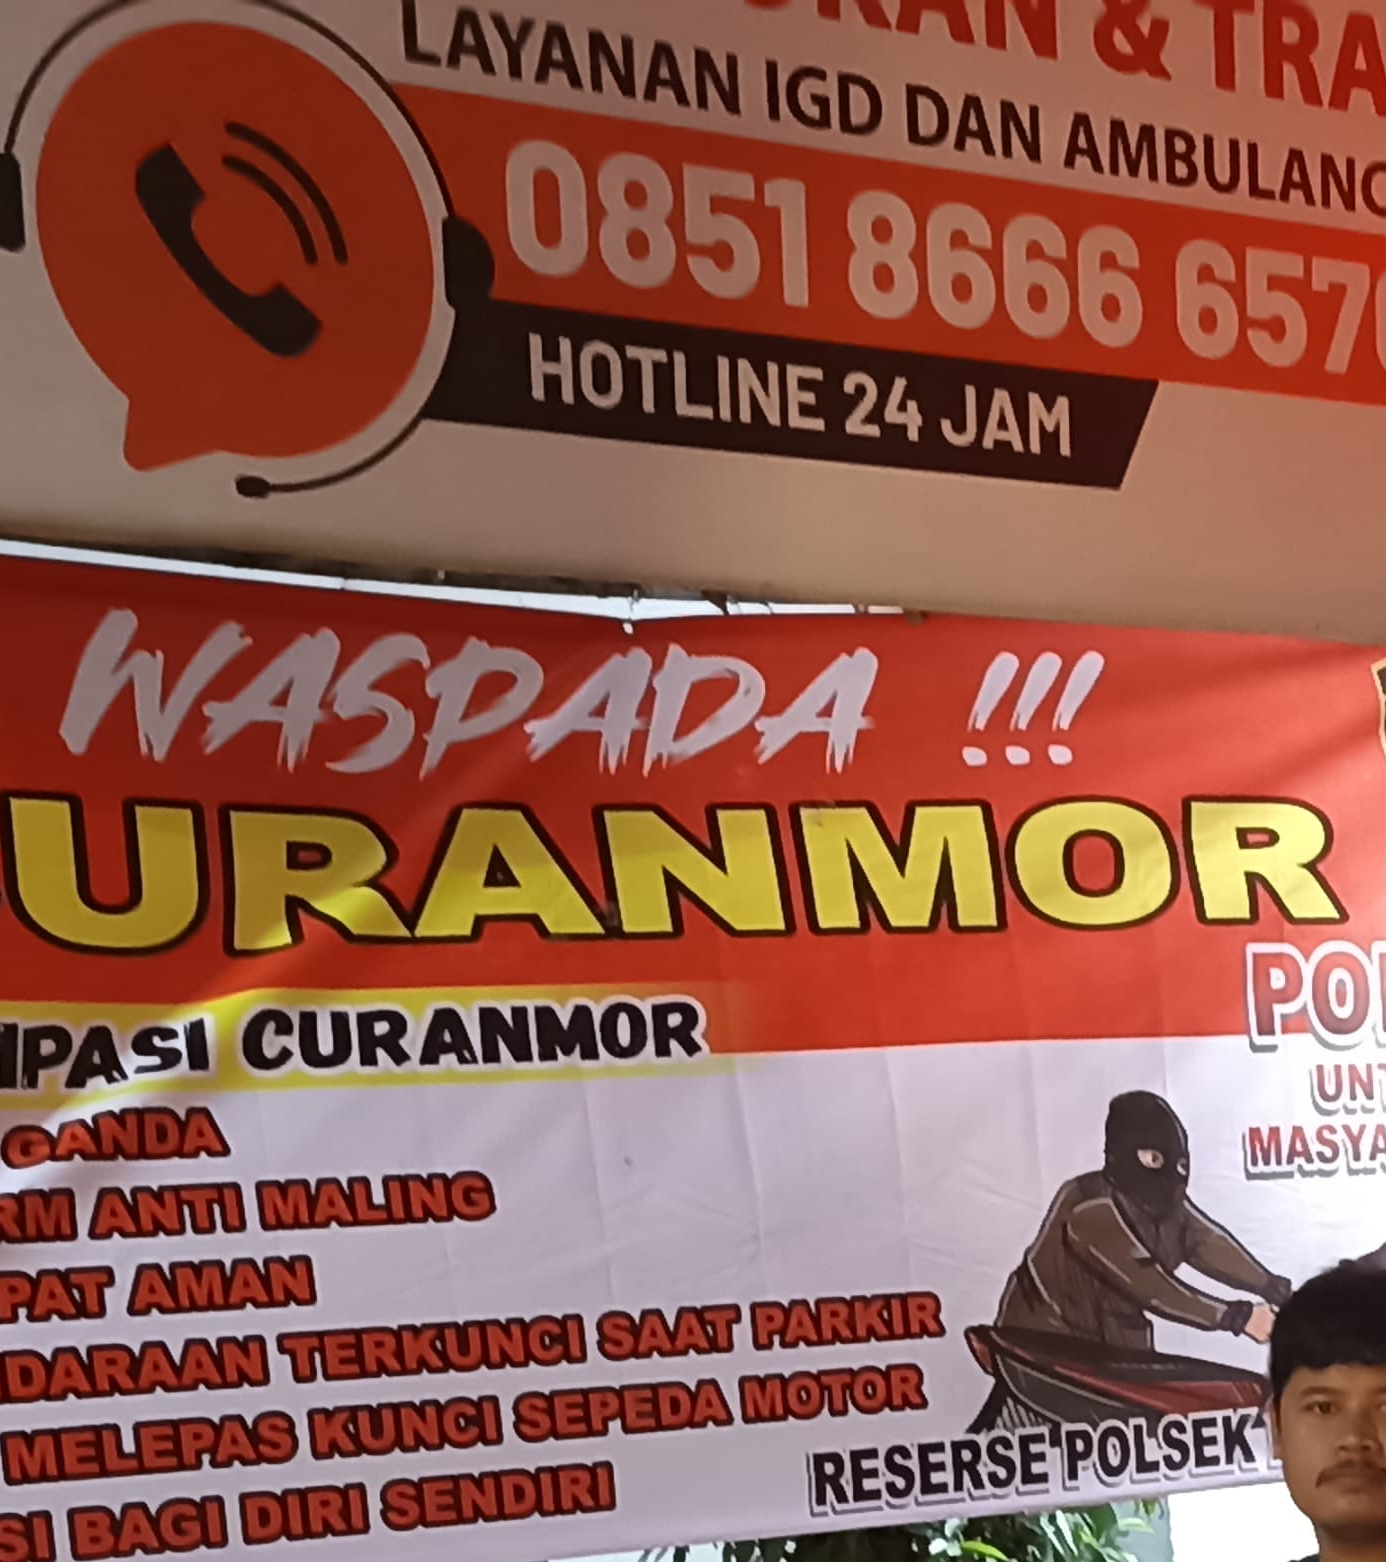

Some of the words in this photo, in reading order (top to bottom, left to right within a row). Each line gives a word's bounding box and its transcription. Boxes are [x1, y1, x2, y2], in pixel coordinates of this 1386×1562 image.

[402, 0, 742, 116] LAYANAN
[766, 57, 884, 136] IGD
[904, 82, 1042, 163] DAN
[506, 138, 810, 308] 0851
[846, 190, 1144, 349] 8666
[529, 332, 825, 433] HOTLINE
[843, 371, 922, 443] 24
[939, 383, 1073, 459] JAM
[59, 607, 879, 781] WASPADA
[962, 649, 1106, 768] !!!
[242, 1001, 703, 1071] CURANMOR
[2, 1106, 231, 1169] GANDA
[89, 1182, 246, 1240] ANTI
[256, 1171, 497, 1232] MALING
[128, 1254, 318, 1317] AMAN
[279, 1313, 586, 1384] TERKUNCI
[597, 1303, 741, 1361] SAAT
[750, 1291, 945, 1349] PARKIR
[2, 1408, 297, 1486] MELEPAS
[309, 1394, 503, 1460] KUNCI
[512, 1382, 731, 1443] SEPEDA
[740, 1363, 928, 1422] MOTOR
[814, 1431, 1050, 1507] RESERSE
[1065, 1411, 1257, 1480] POLSEK
[241, 1482, 368, 1546] DIRI
[380, 1461, 617, 1529] SENDIRI
